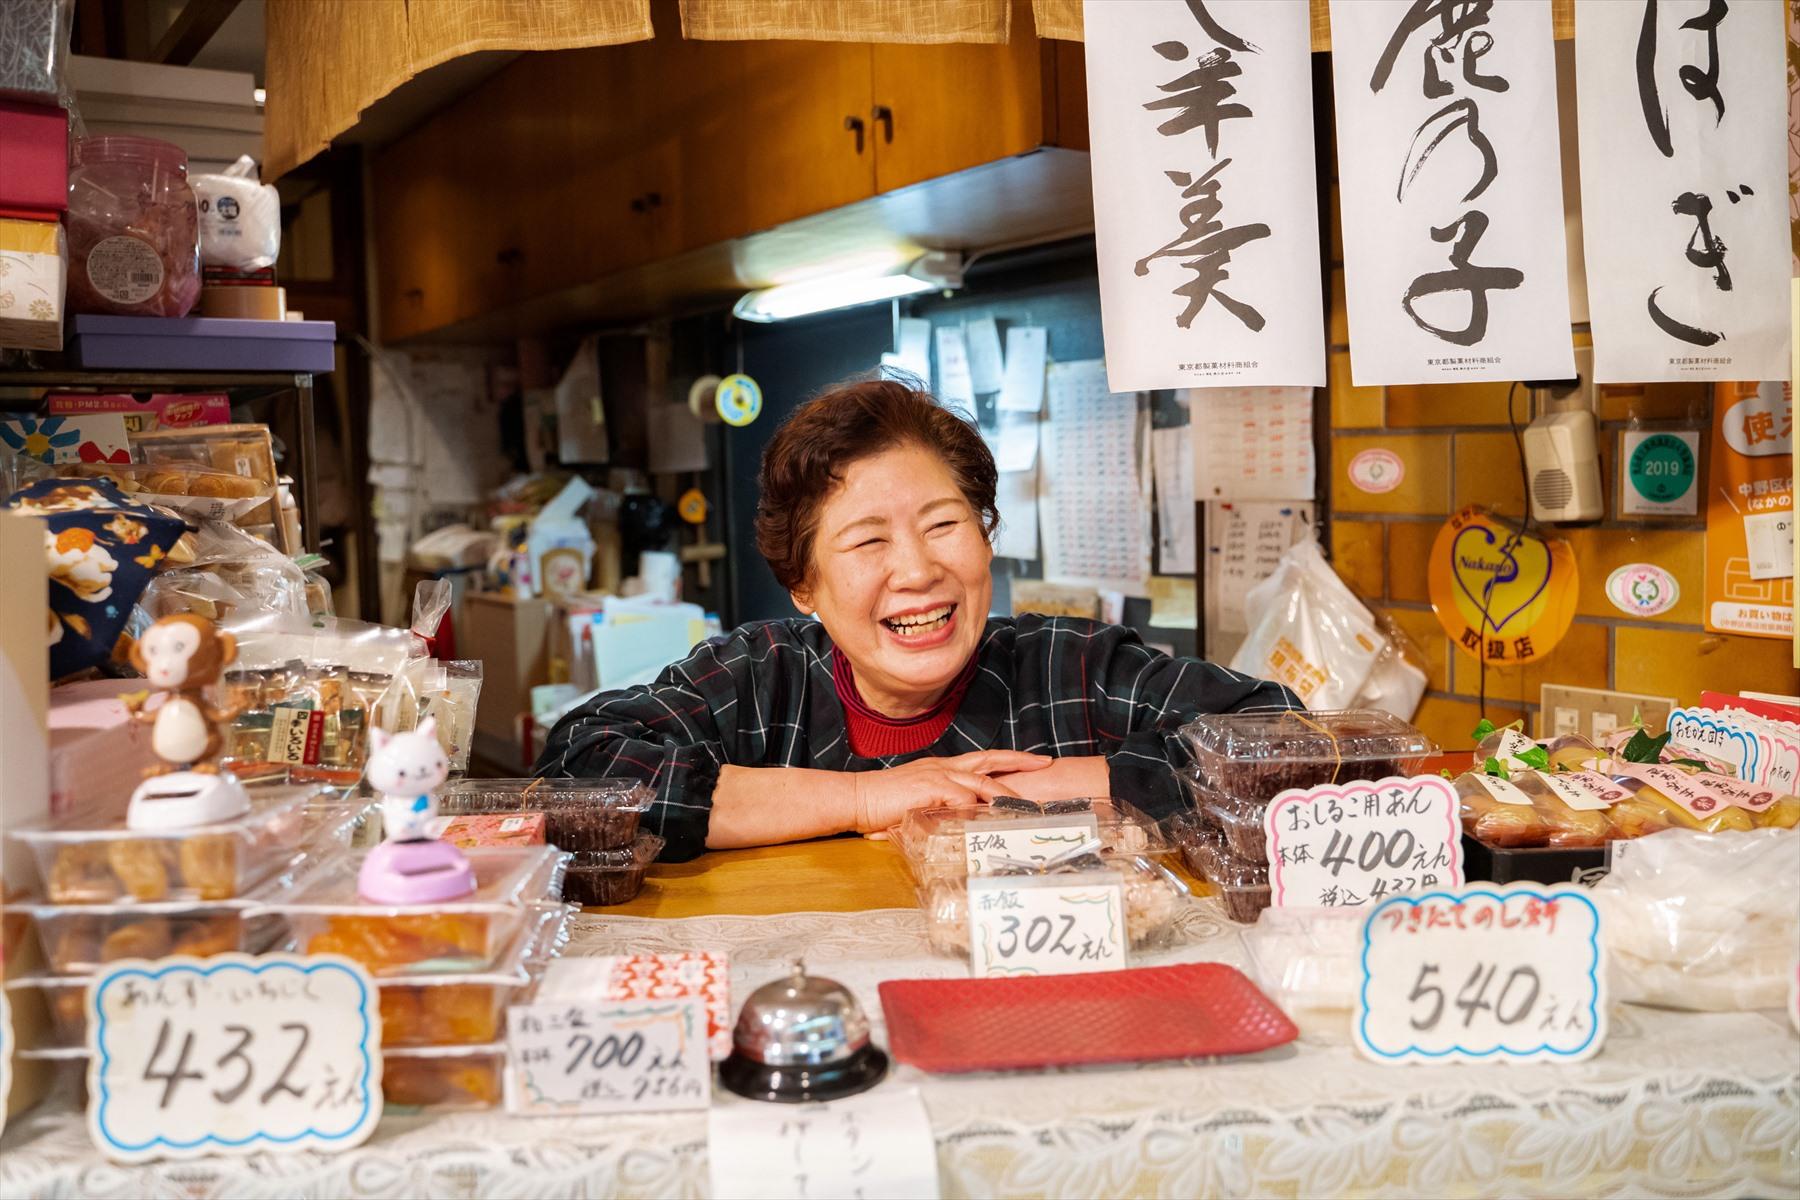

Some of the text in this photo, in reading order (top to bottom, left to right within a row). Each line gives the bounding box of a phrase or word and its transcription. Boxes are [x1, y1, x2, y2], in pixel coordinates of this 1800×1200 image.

[1645, 460, 1679, 476] 2019
[1459, 556, 1512, 573] Nakano
[1461, 627, 1534, 659] 取扱店
[1287, 787, 1432, 831] おしるこ用あん
[969, 833, 1008, 852] 赤飯
[1276, 843, 1314, 867] 本体
[978, 891, 1024, 911] 赤飯
